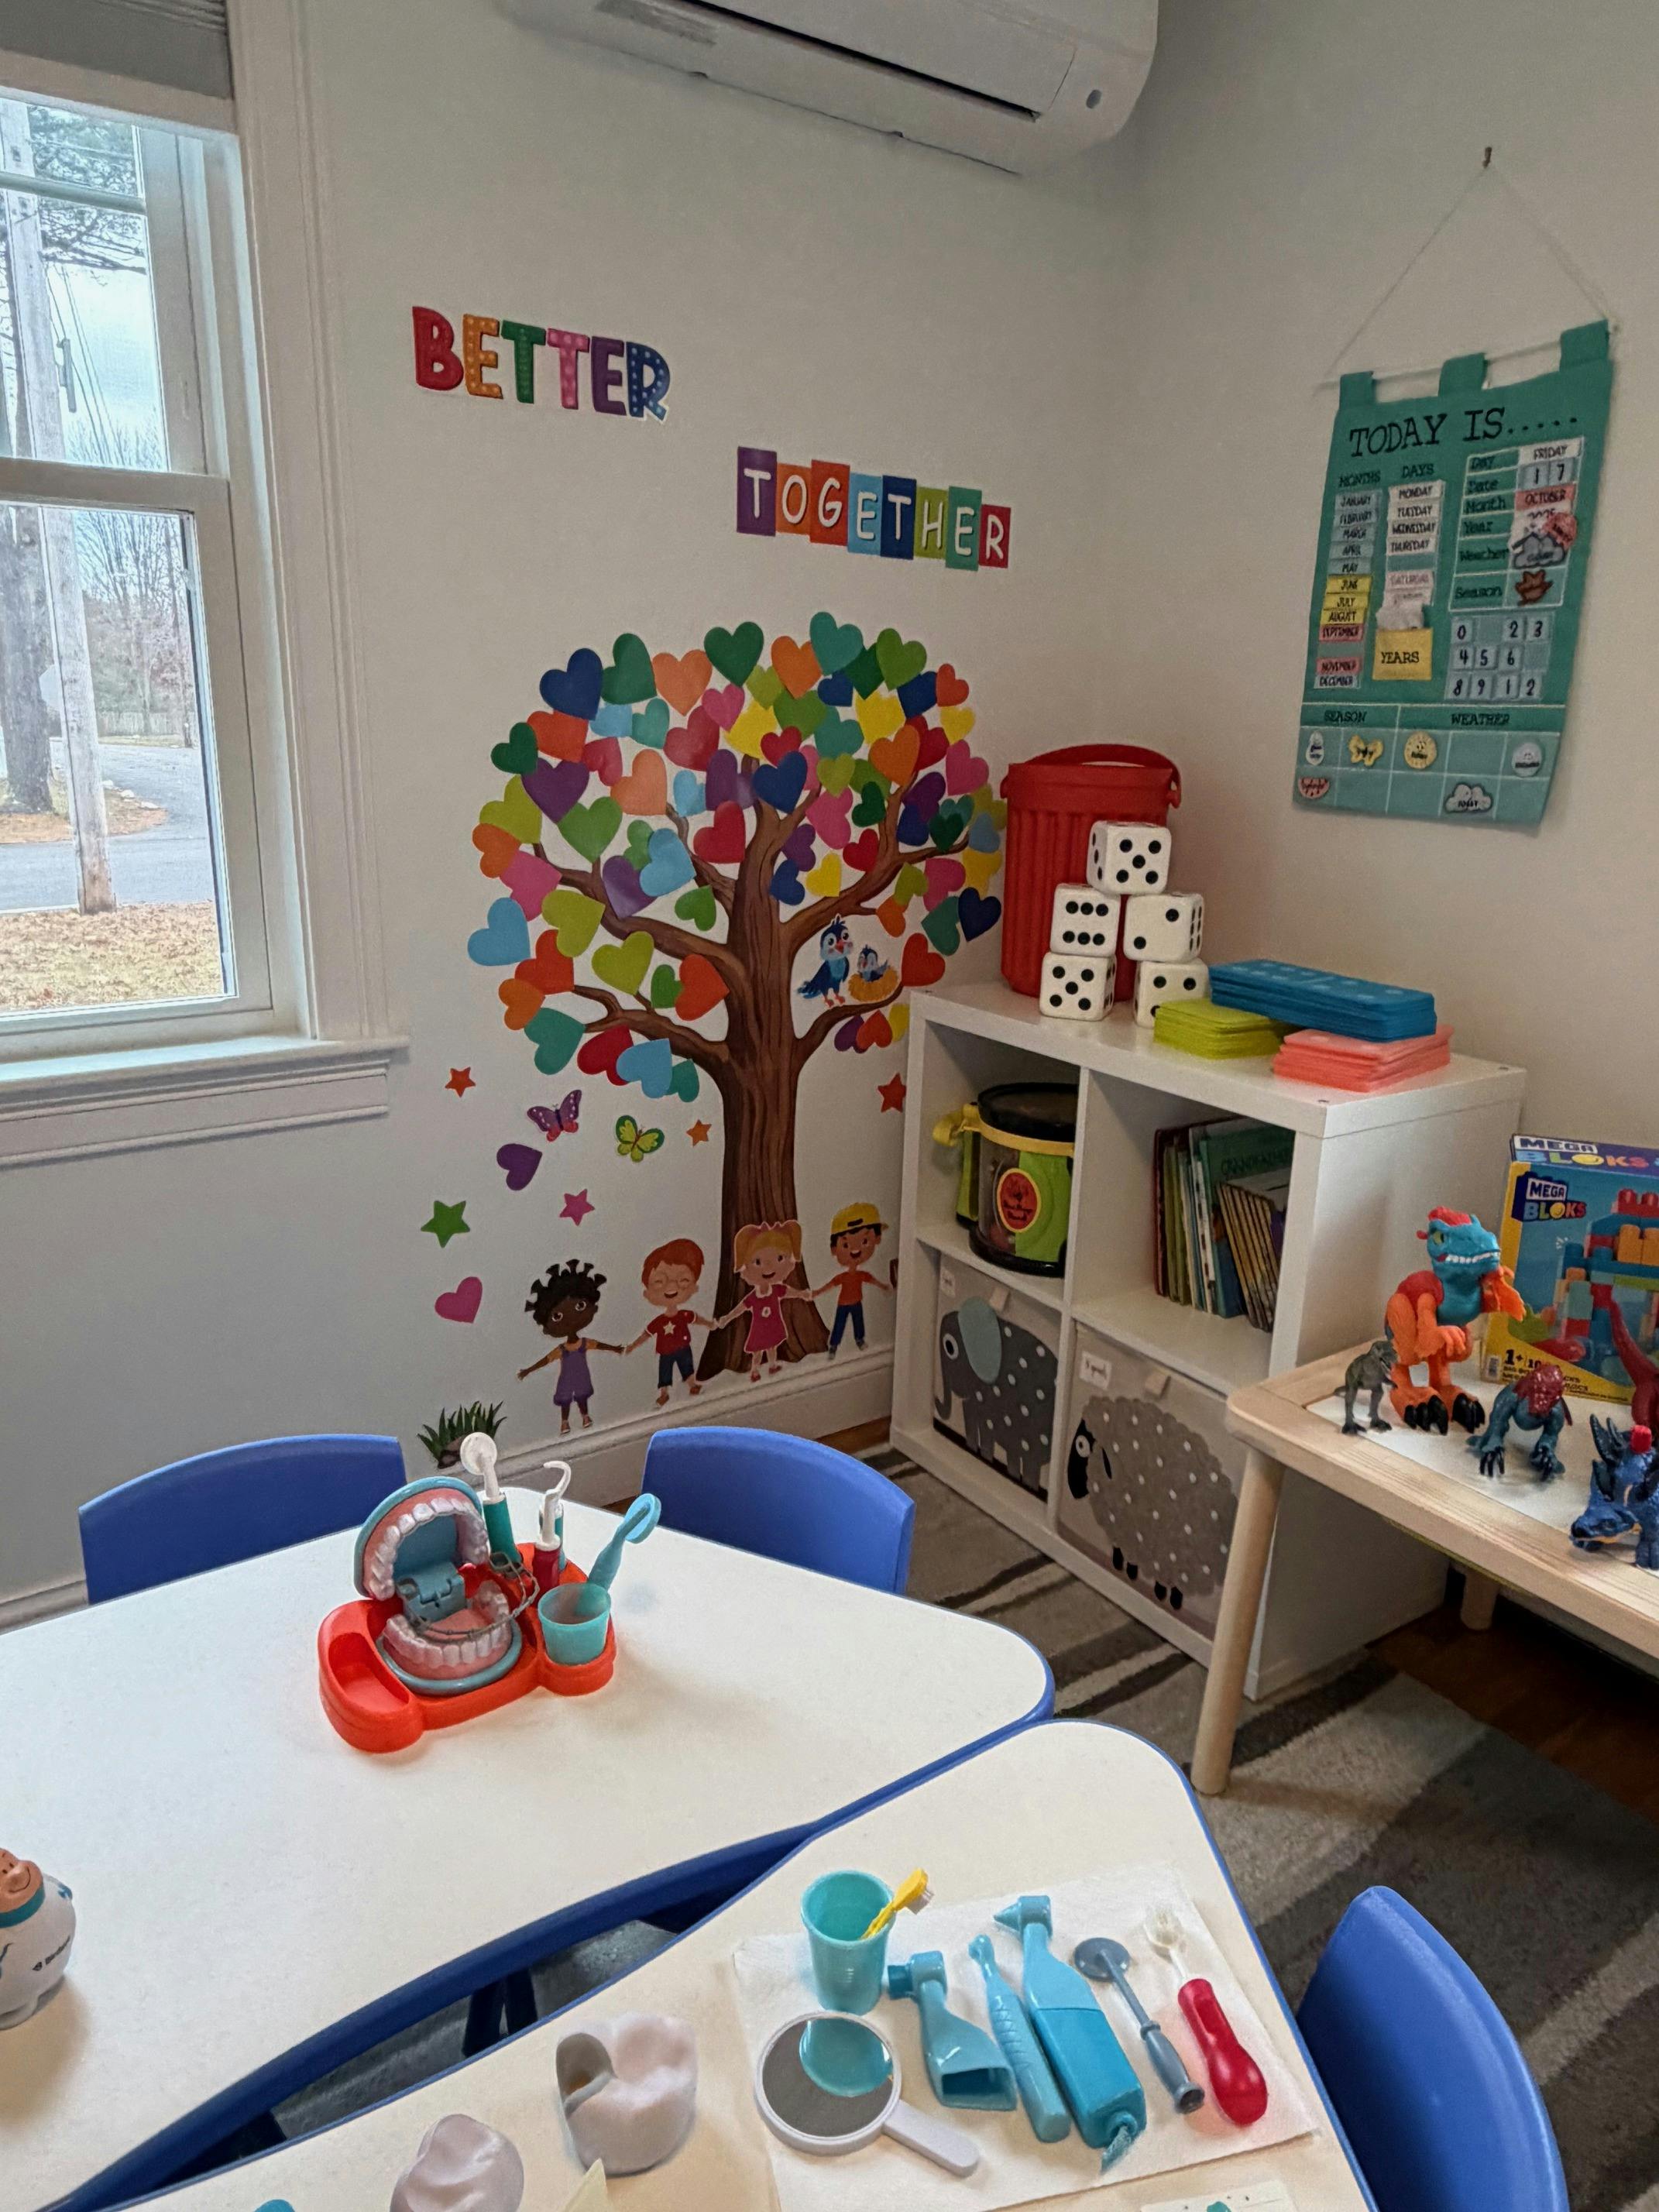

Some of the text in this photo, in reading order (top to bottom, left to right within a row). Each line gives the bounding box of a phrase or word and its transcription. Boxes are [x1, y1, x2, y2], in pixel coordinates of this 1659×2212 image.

[413, 306, 671, 423] BETTER
[1349, 413, 1448, 457] TODAY
[1534, 445, 1568, 460] FRIDAY
[1339, 469, 1381, 488] MONTHS
[1400, 463, 1434, 479] DAYS
[1398, 485, 1434, 500] MONDAY
[1524, 489, 1566, 505] OCTOBER
[1339, 496, 1371, 508] JANUARY
[742, 466, 1005, 561] TOGETHER
[1339, 512, 1373, 525] FEBRUARY
[1396, 505, 1433, 519] TUESDAY
[1393, 520, 1436, 535] WEDNESDAY
[1390, 540, 1430, 553] THURSDAY
[1341, 562, 1358, 573] MAY
[1455, 584, 1503, 599] Season
[1328, 611, 1357, 623] AUGUST
[1322, 626, 1358, 638] SEPTEMBER
[1508, 620, 1519, 637] 2
[1533, 621, 1544, 637] 3
[1381, 651, 1420, 665] YEARS
[1459, 648, 1515, 665] 4 5 6
[1321, 661, 1356, 672] NOVEMBER
[1319, 676, 1353, 687] DECEMBER
[1453, 679, 1462, 696] 8
[1478, 678, 1486, 696] 9
[1525, 678, 1536, 696] 2
[1324, 710, 1366, 723] SEASON
[1451, 713, 1510, 726] WEATHER
[1520, 1138, 1594, 1152] MEGA
[1516, 1150, 1649, 1168] BLOKS
[1530, 1181, 1565, 1198] MEGA
[1523, 1201, 1586, 1221] BLOKS
